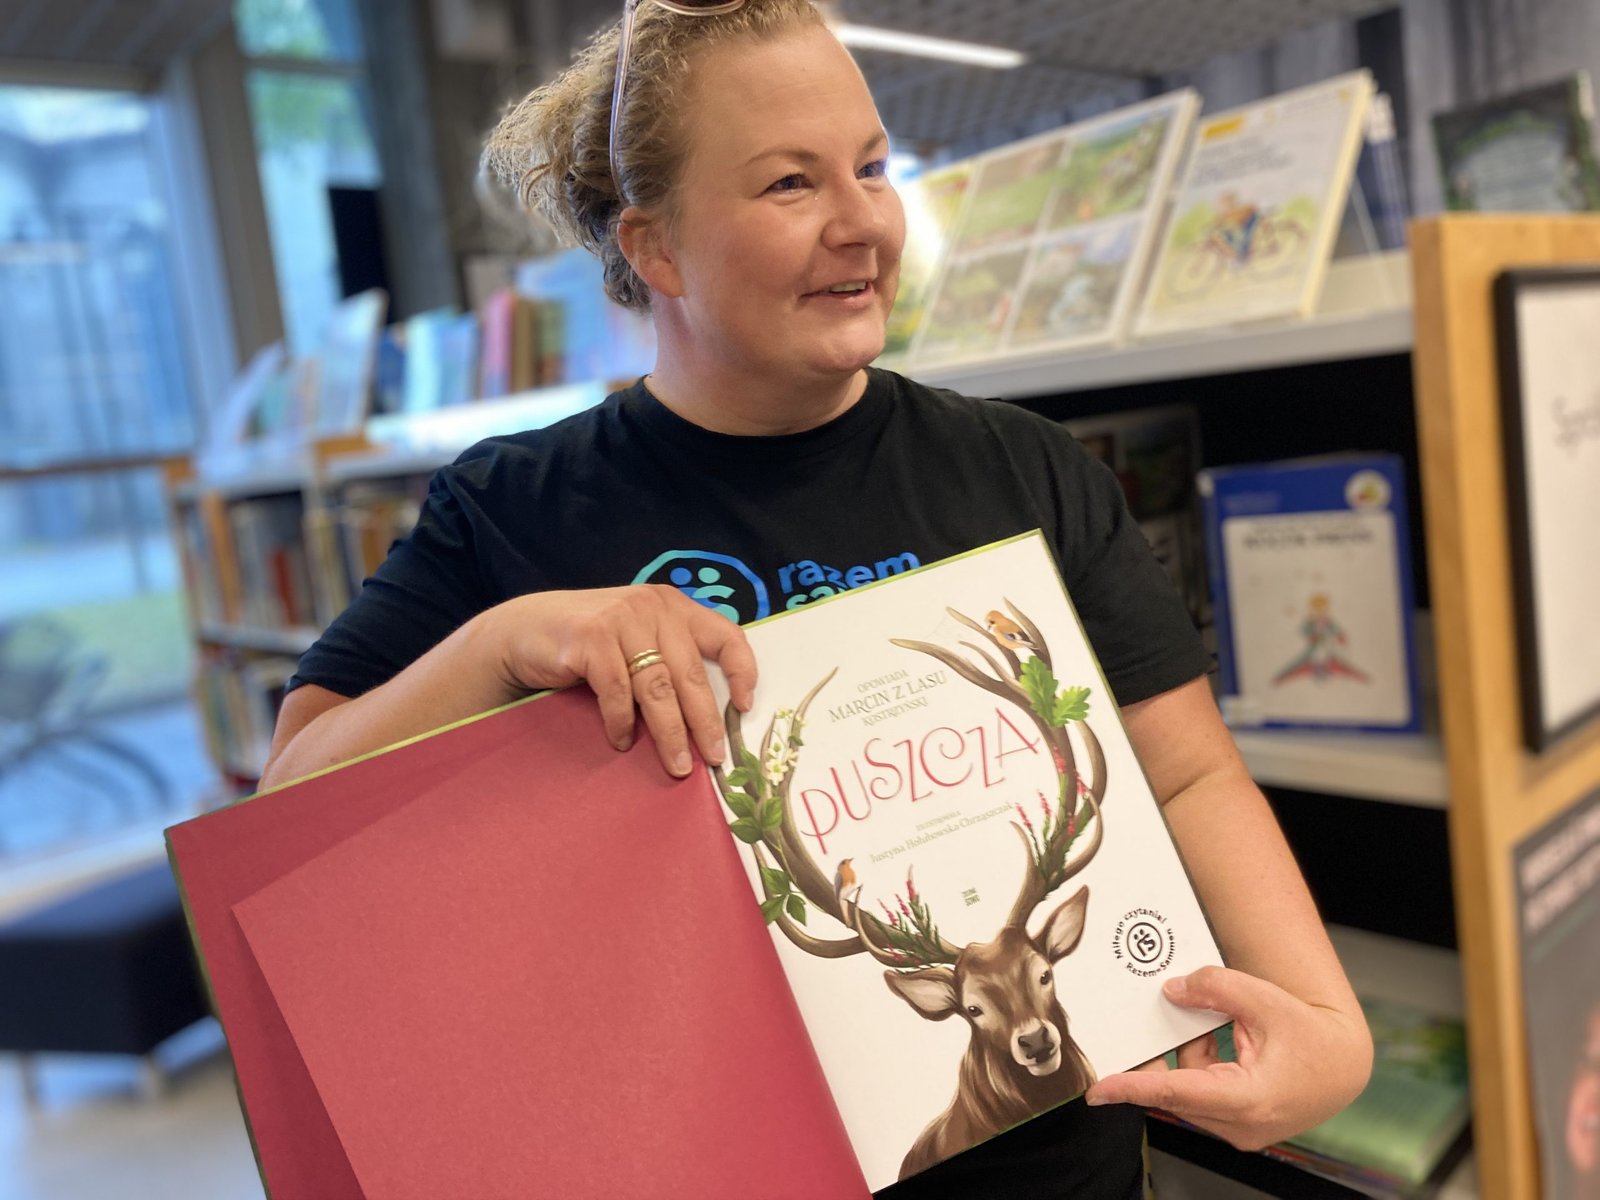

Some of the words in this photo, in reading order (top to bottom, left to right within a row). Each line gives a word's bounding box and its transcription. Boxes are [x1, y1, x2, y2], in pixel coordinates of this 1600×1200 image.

[778, 552, 921, 594] razem
[829, 690, 890, 722] MARCIN
[892, 685, 906, 700] Z
[906, 670, 946, 694] LASU
[800, 708, 1040, 855] PUSZCZA
